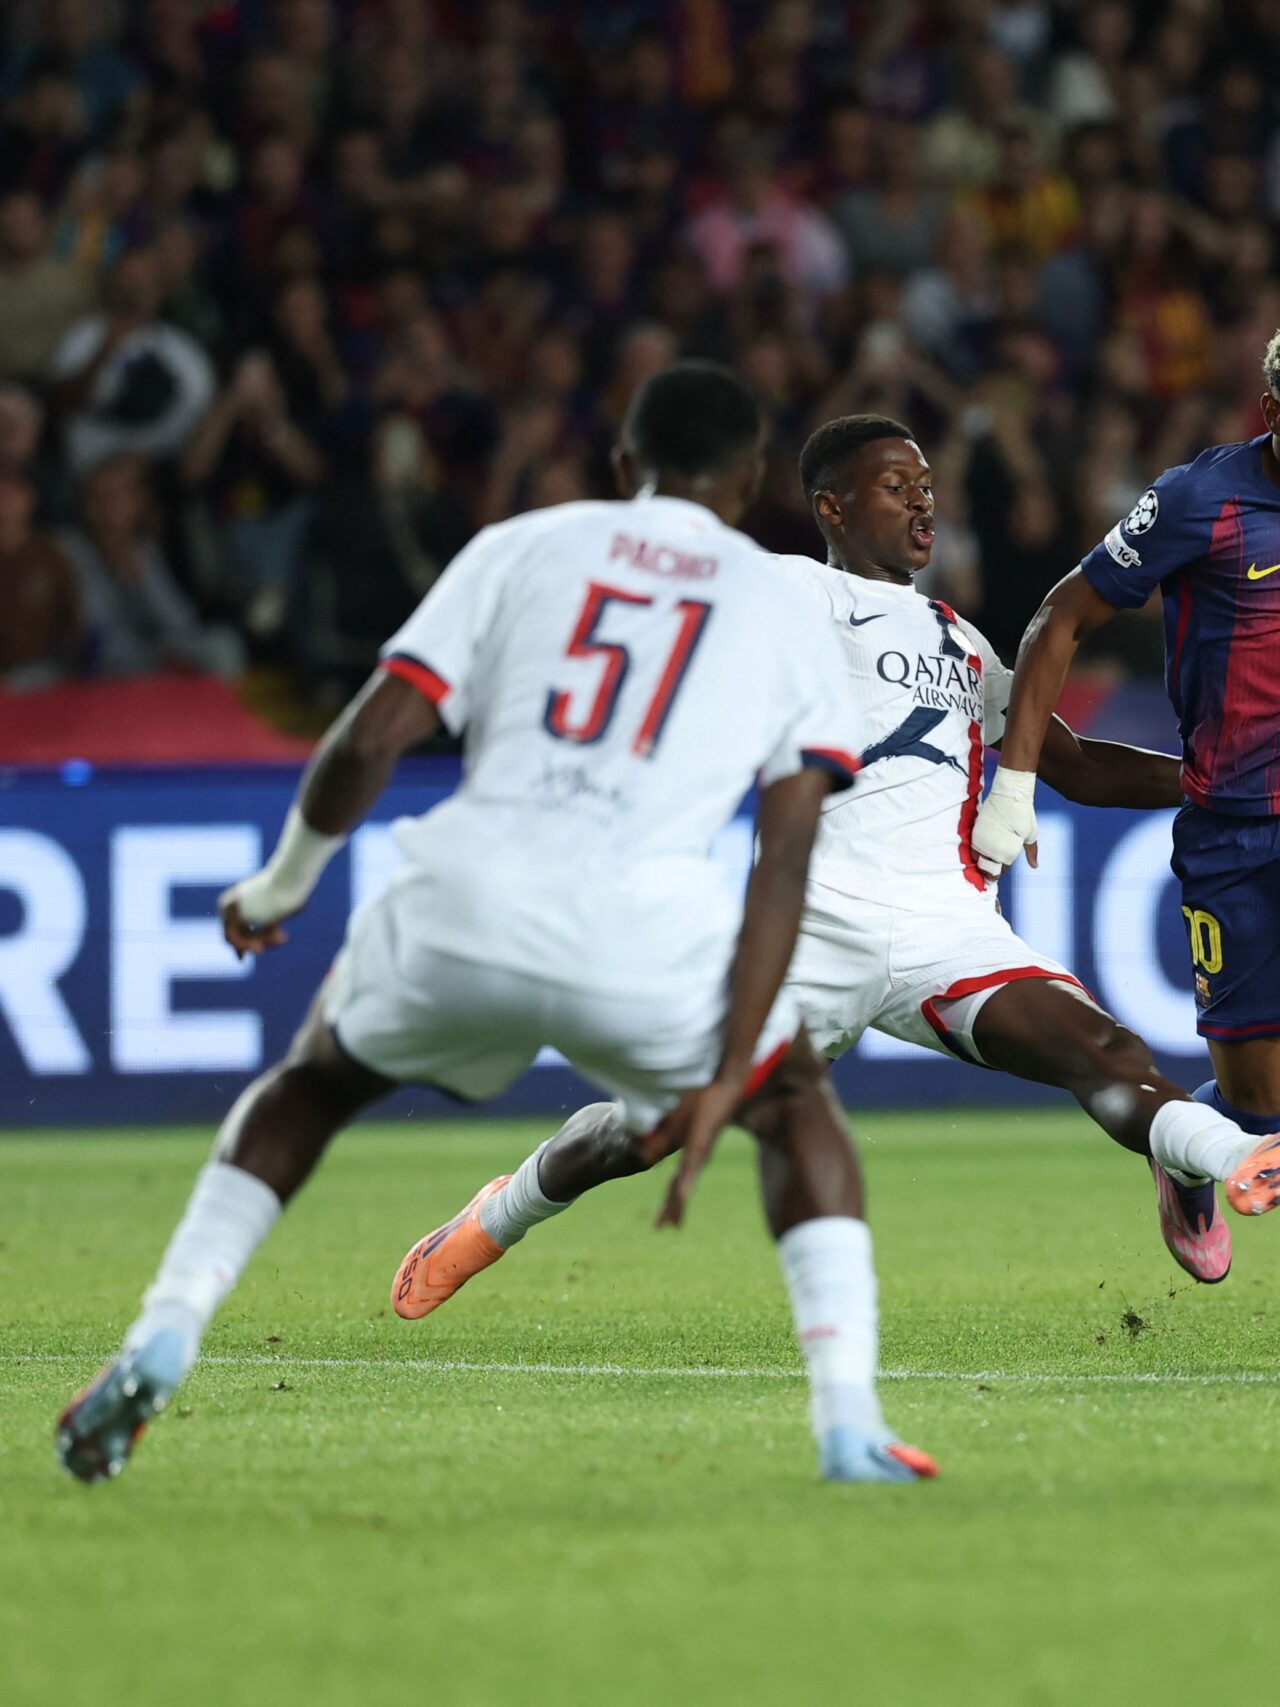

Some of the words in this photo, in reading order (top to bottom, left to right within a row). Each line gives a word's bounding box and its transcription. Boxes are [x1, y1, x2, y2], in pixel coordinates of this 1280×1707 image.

[608, 531, 719, 581] PACHO
[543, 580, 714, 759] 51
[876, 651, 982, 700] QATAR
[912, 685, 983, 723] AIRWAYS
[1181, 905, 1223, 974] 10
